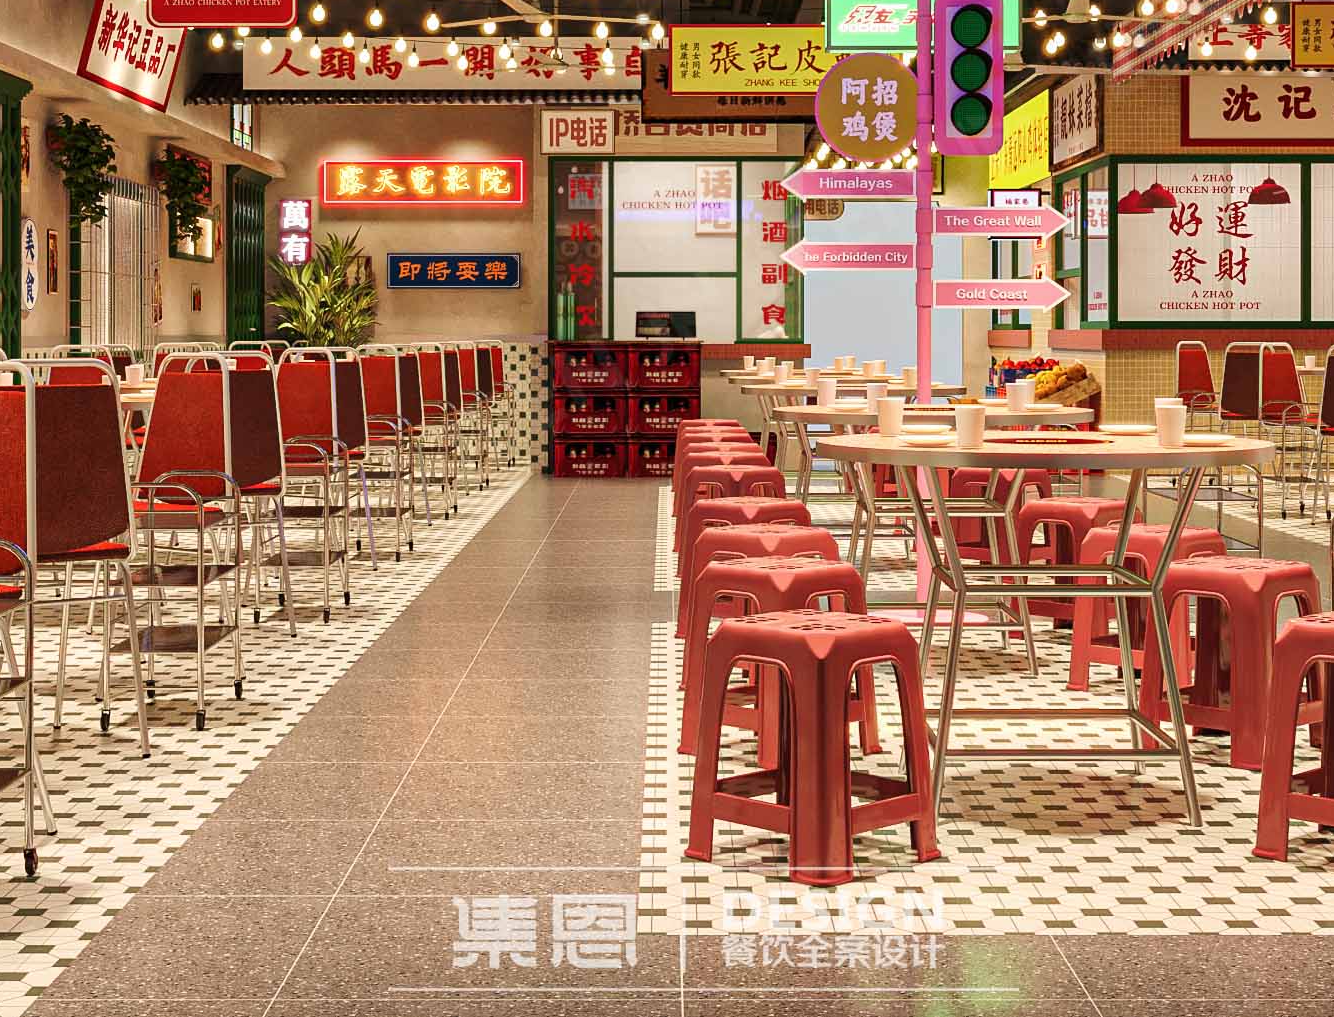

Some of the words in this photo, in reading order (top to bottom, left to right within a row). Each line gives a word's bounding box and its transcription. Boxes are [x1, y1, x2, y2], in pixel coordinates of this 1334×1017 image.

[97, 2, 177, 80] 新华记豆品厂
[710, 39, 851, 76] 張記皮
[841, 77, 899, 106] 阿招
[549, 117, 609, 148] IP电话
[841, 111, 899, 143] 鸡煲
[336, 165, 513, 195] 露天電影院
[818, 177, 893, 190] Himalayas
[1192, 174, 1199, 182] A
[1203, 174, 1234, 182] ZHAO
[653, 190, 661, 198] A
[665, 190, 696, 198] ZHAO
[1212, 186, 1236, 194] HOT
[1239, 186, 1261, 194] PO
[622, 201, 671, 210] CHICKEN
[675, 201, 698, 210] HOT
[701, 201, 723, 210] POT
[944, 215, 970, 227] The
[973, 215, 1011, 227] Great
[1014, 215, 1043, 227] Wall
[1168, 201, 1255, 239] 好運
[803, 252, 820, 262] he
[823, 252, 882, 262] Forbidden
[885, 252, 908, 265] City
[1168, 246, 1254, 286] 發財
[955, 288, 986, 300] Gold
[989, 288, 1028, 300] Coast
[1192, 290, 1199, 298] A
[1203, 290, 1234, 298] ZHAO
[1160, 302, 1209, 310] CHICKEN
[1212, 302, 1236, 310] HOT
[1239, 302, 1261, 310] POT
